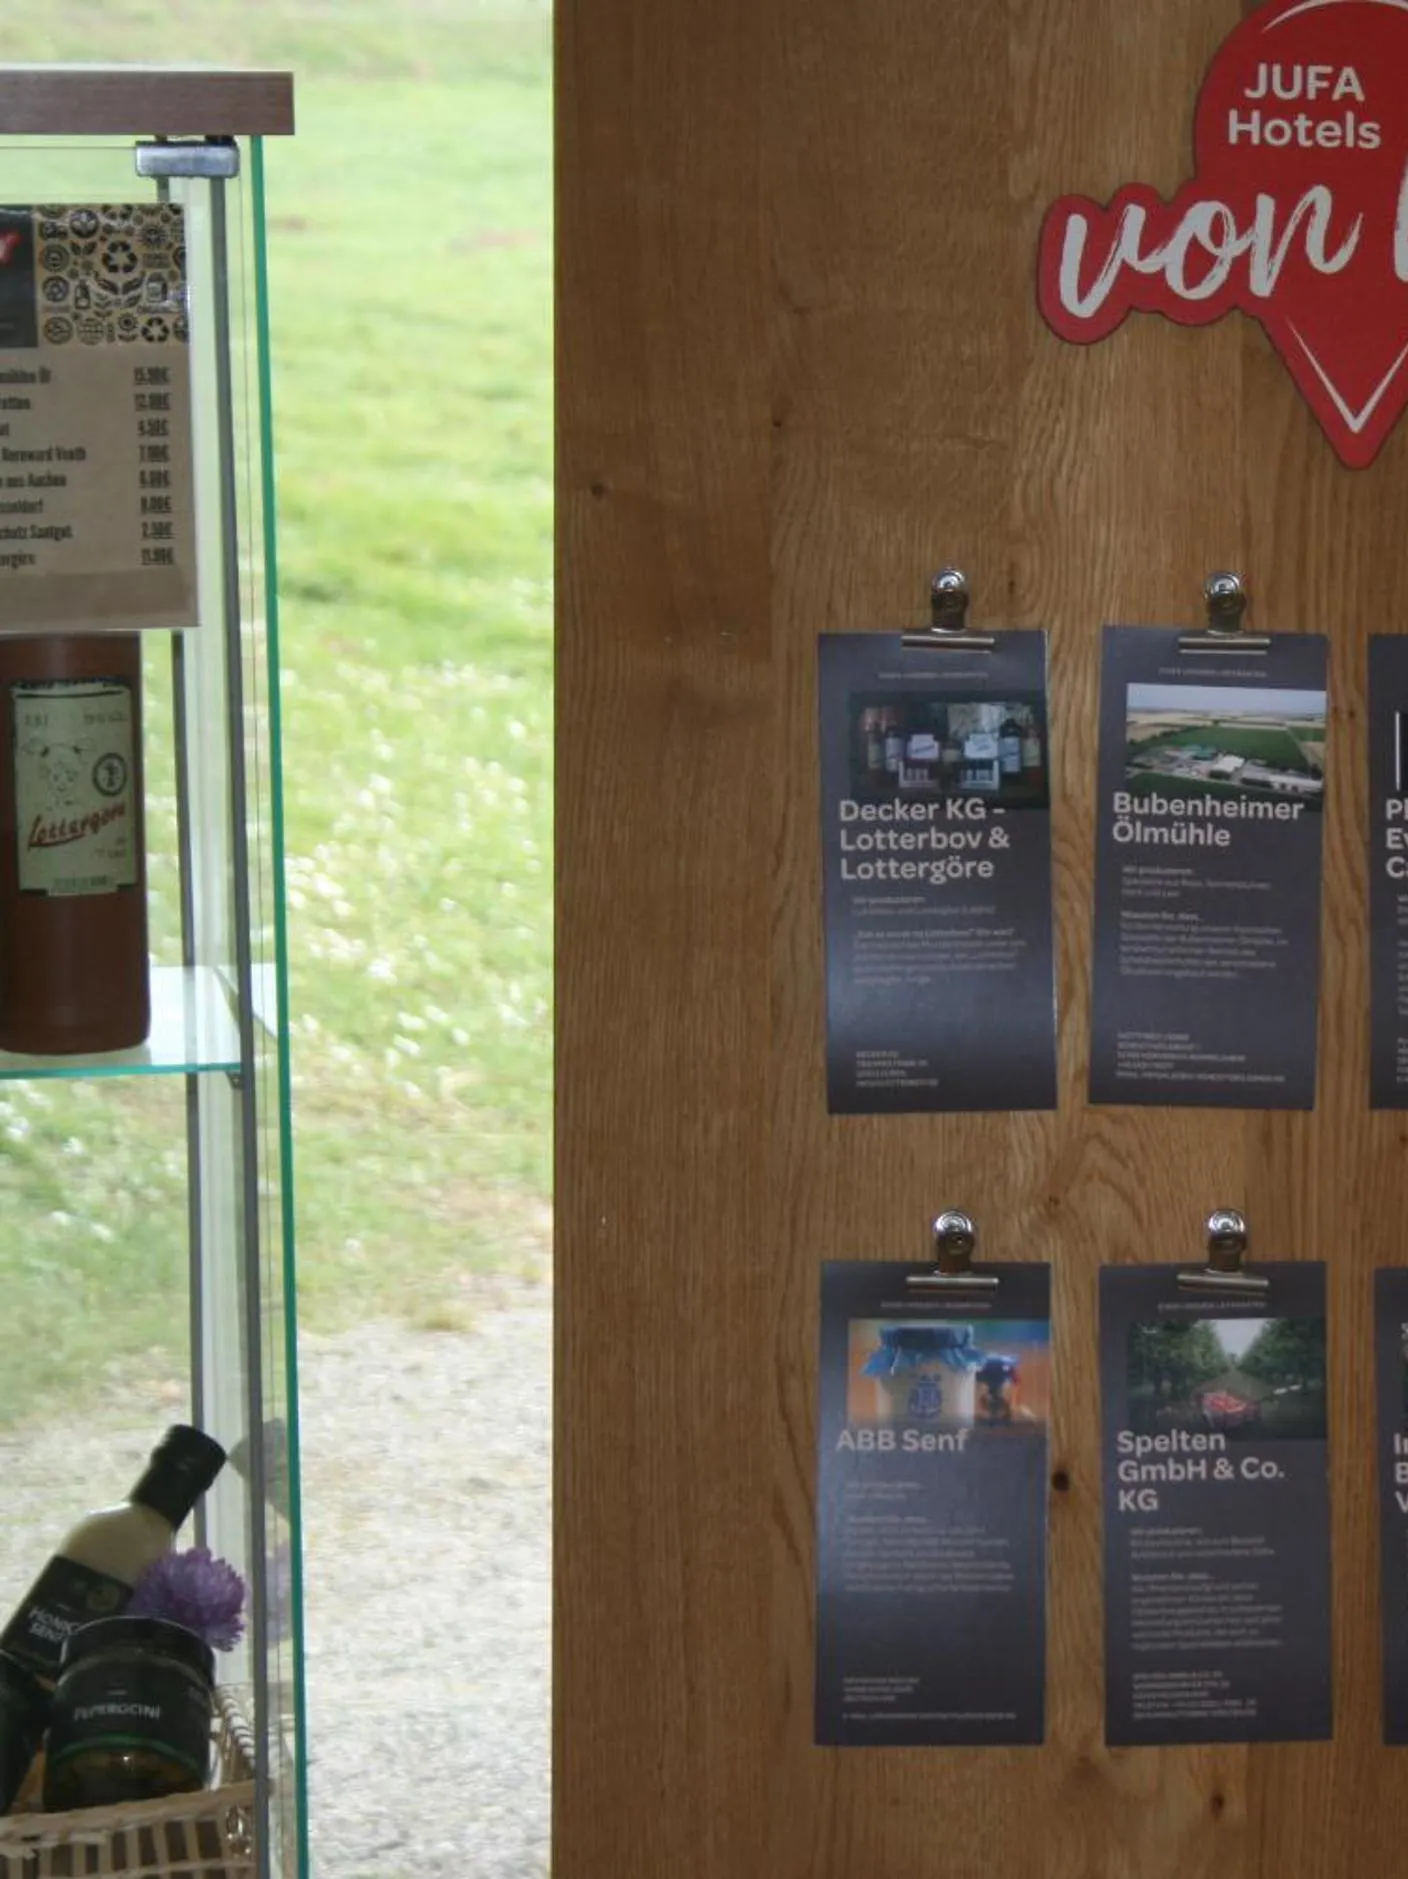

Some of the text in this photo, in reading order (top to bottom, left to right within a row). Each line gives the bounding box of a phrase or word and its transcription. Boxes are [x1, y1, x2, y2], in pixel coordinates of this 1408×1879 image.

[1244, 63, 1366, 102] JUFA
[1228, 109, 1382, 149] Hotels
[1059, 186, 1364, 319] von
[840, 798, 939, 822] Decker
[946, 799, 986, 821] KG
[1113, 792, 1304, 821] Bubenheimer
[989, 827, 1010, 849] &
[1112, 815, 1231, 847] Ölmühle
[841, 856, 995, 884] Lottergöre
[836, 1428, 969, 1452] ABB Senf
[1116, 1429, 1226, 1458] Spelten
[1118, 1457, 1285, 1482] GmbH & Co.
[1118, 1489, 1160, 1512] KG
